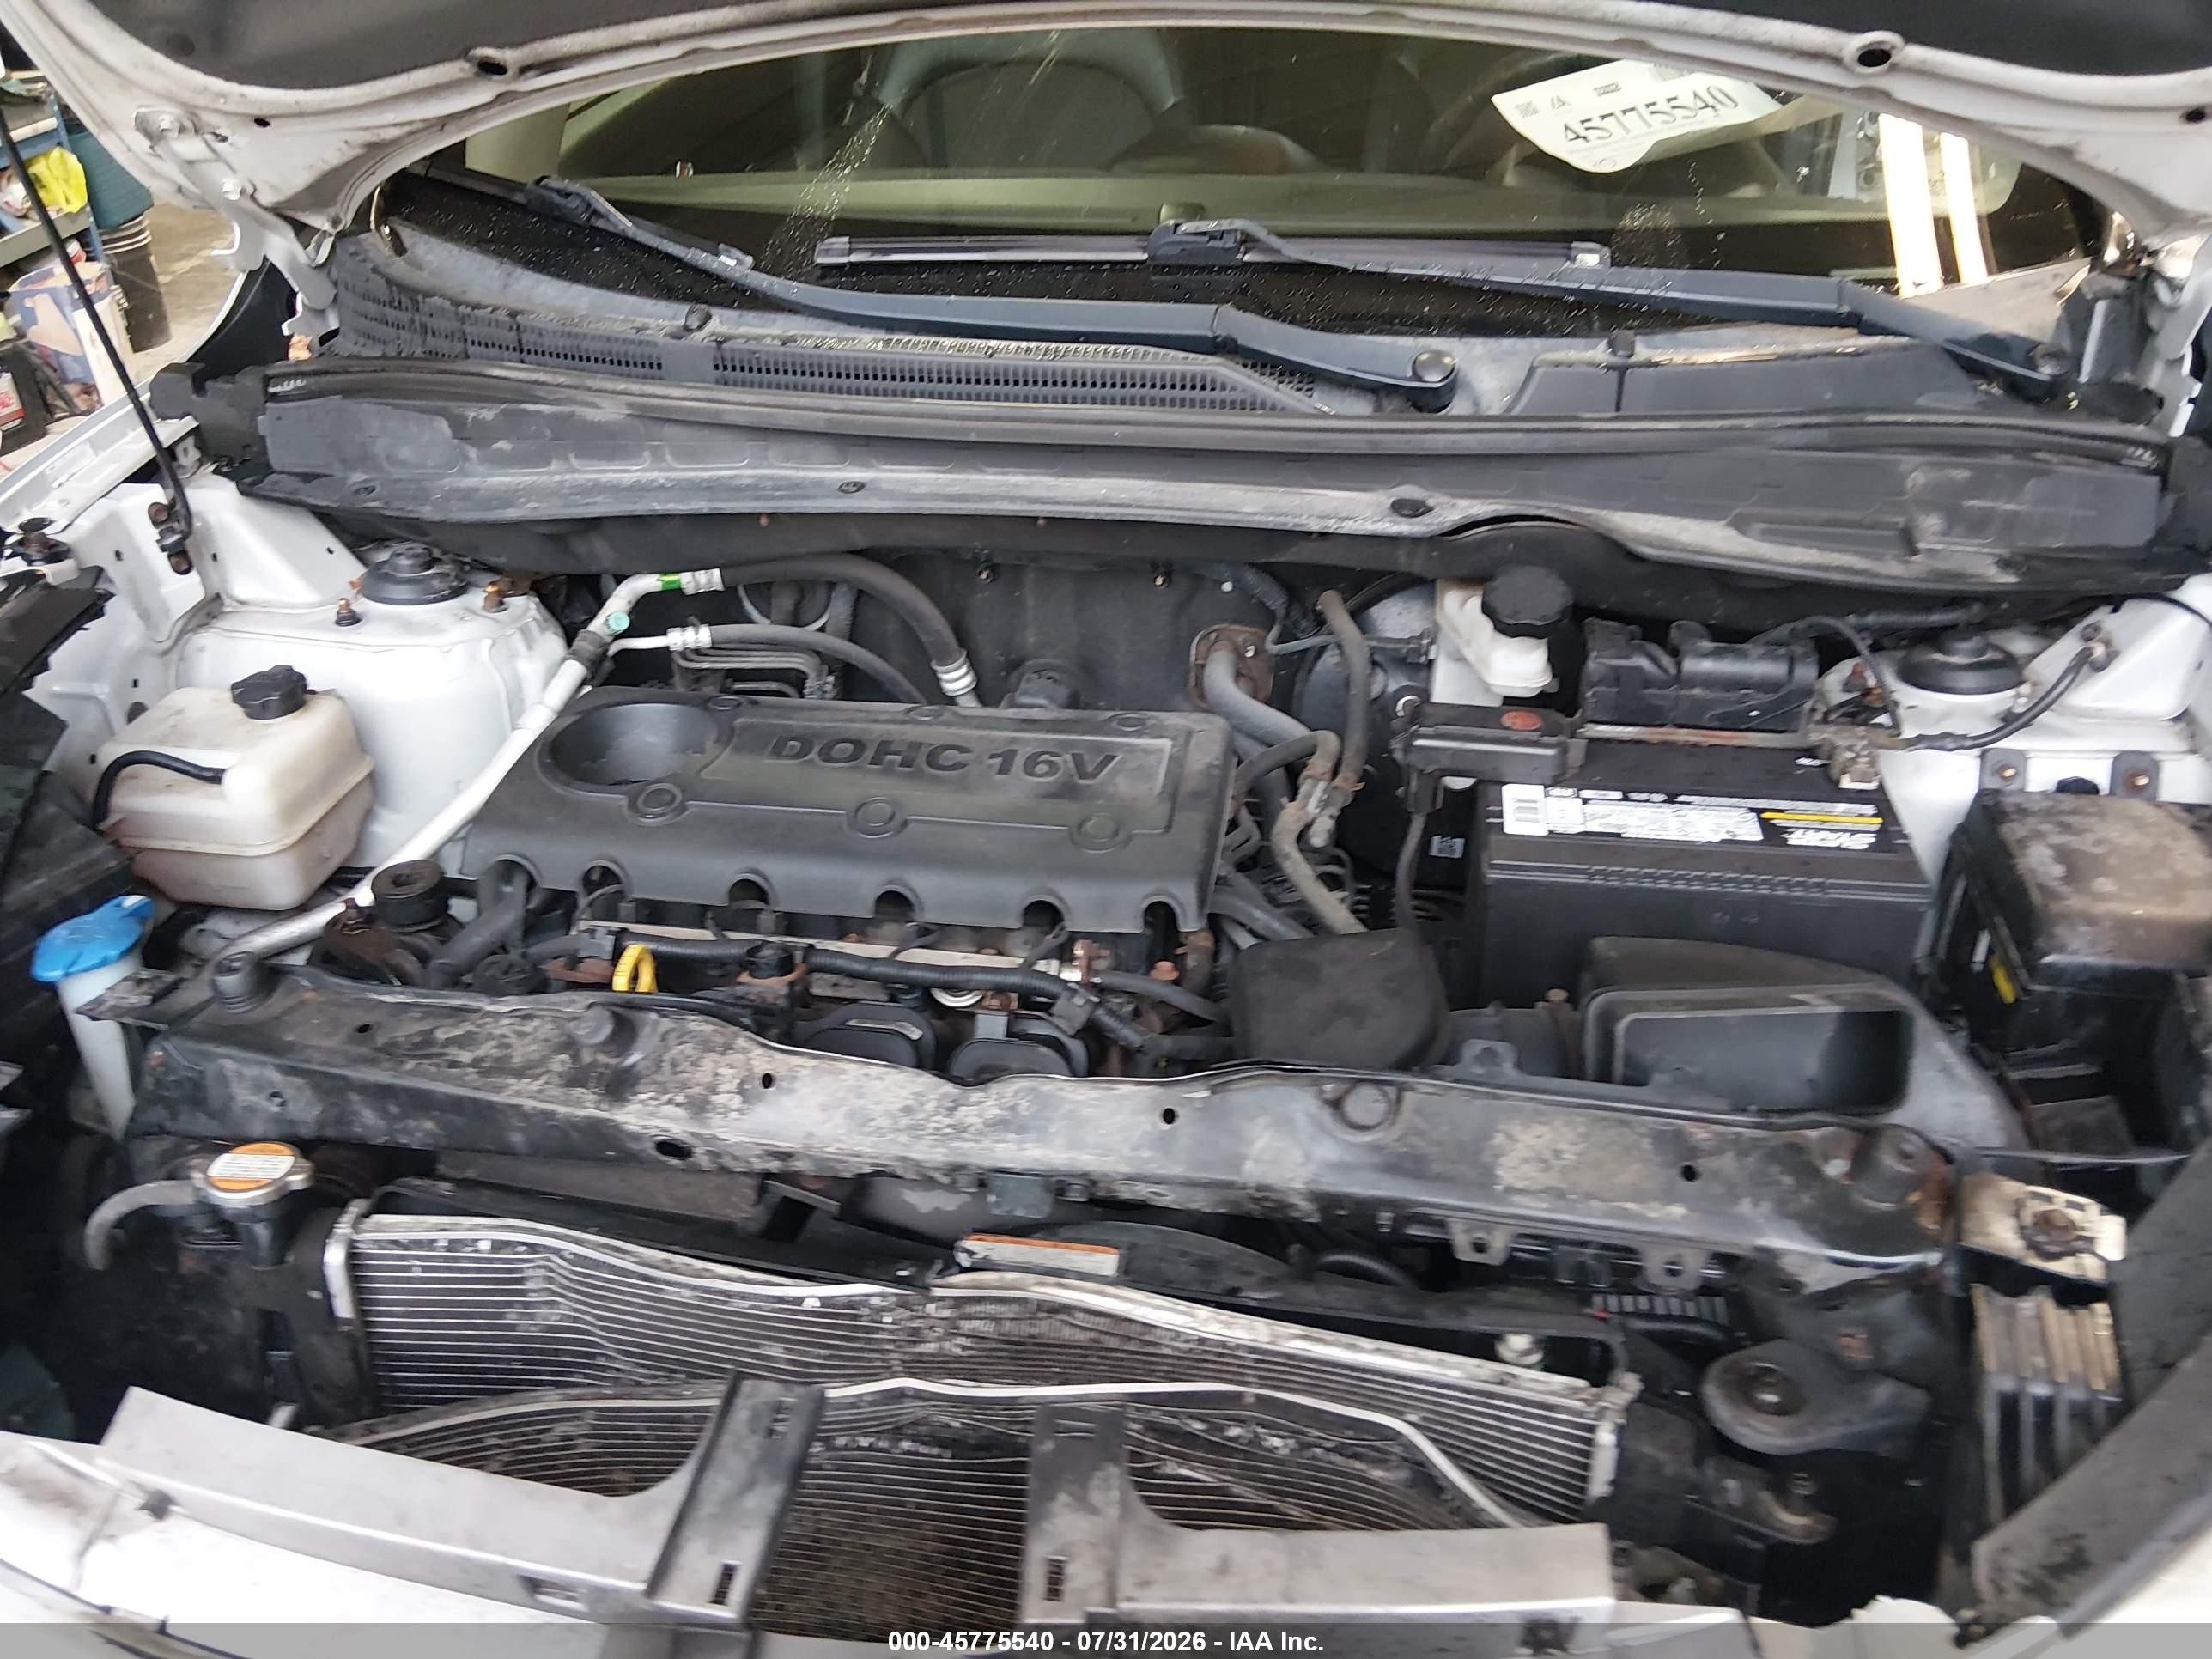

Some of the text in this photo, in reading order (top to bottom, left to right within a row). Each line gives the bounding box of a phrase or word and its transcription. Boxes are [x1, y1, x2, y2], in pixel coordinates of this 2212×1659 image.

[1562, 84, 1740, 144] 45775540
[768, 734, 1119, 781] DOHC 16V
